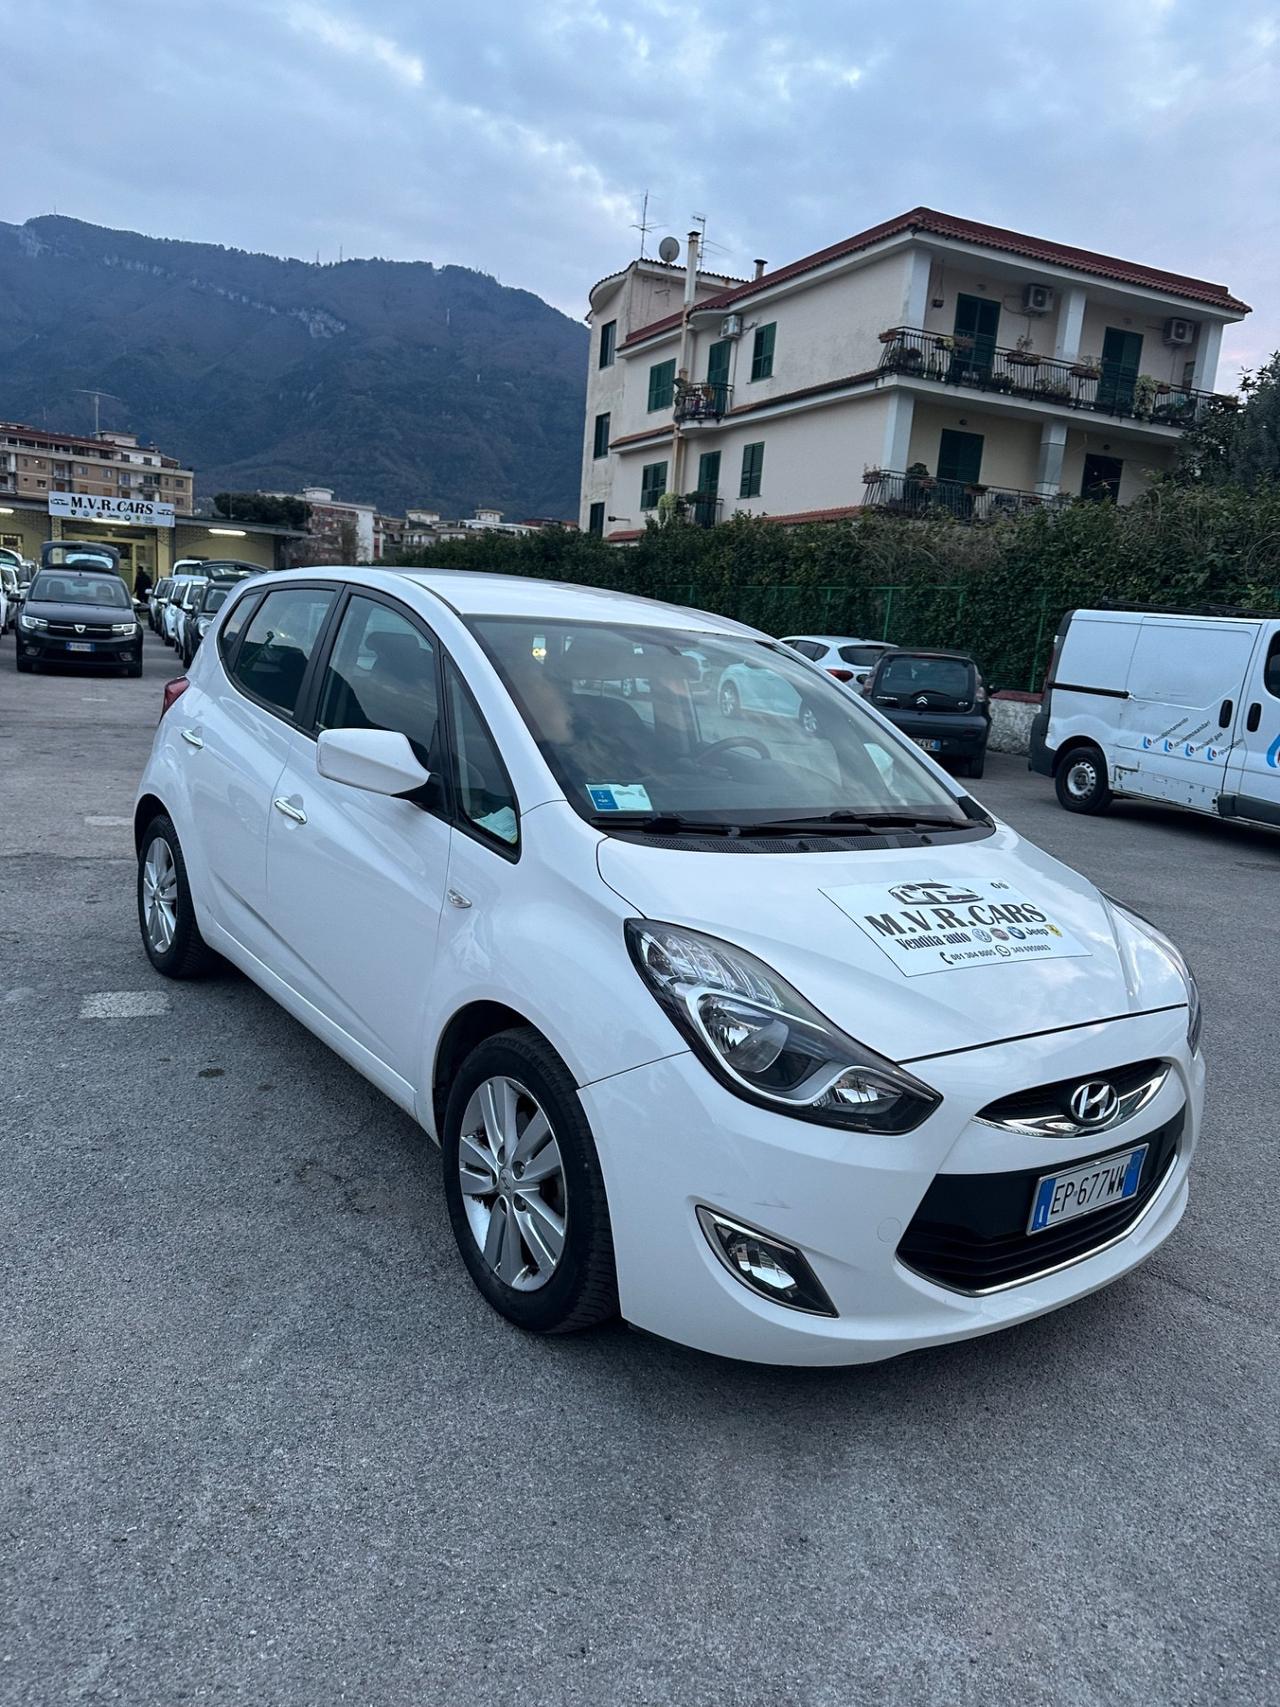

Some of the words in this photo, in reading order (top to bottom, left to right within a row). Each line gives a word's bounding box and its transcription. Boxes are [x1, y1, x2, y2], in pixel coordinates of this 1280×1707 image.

[71, 496, 153, 515] M.V.R.CARS
[864, 903, 1047, 937] M.V.R.CARS
[895, 934, 945, 951] Vendita
[943, 931, 972, 945] auto
[1025, 927, 1049, 937] Jeep
